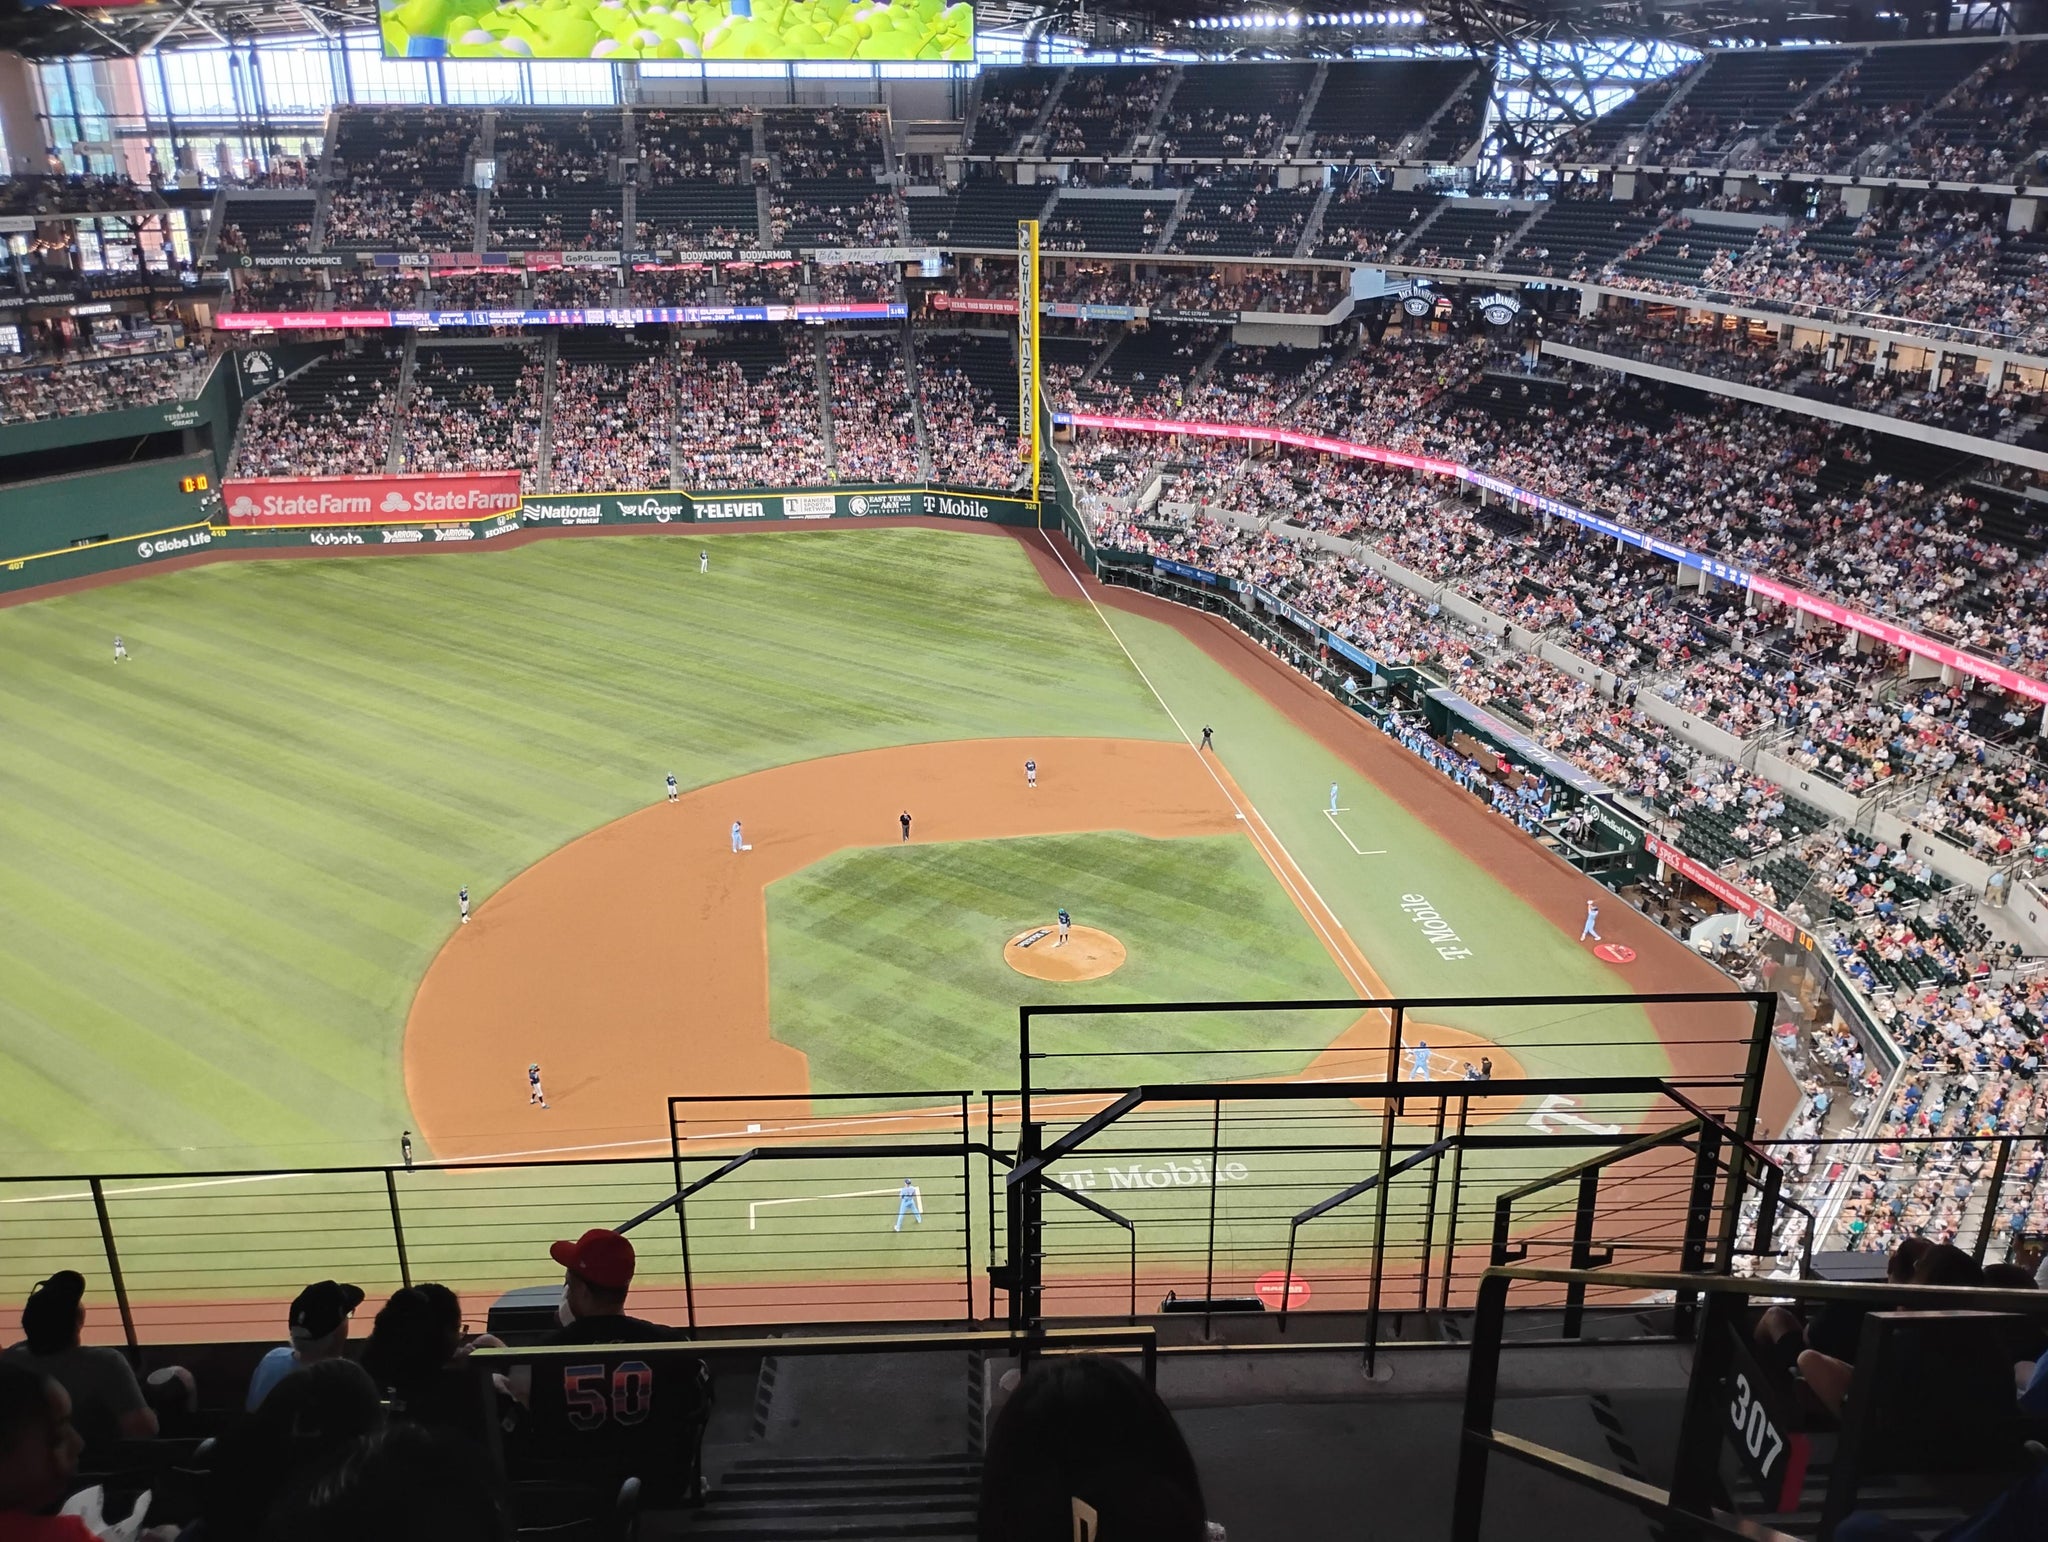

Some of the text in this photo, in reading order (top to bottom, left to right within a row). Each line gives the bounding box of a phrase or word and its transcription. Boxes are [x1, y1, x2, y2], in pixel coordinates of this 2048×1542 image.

[255, 256, 342, 265] PRIORITY COMMERCE
[398, 255, 430, 264] 105.3
[536, 254, 560, 263] PGL
[565, 254, 617, 262] GoPGL.com
[630, 254, 654, 262] PGL
[680, 251, 733, 261] BODYARMOR
[740, 250, 792, 261] BODYARMOR
[818, 248, 842, 260] Blue
[849, 248, 878, 260] Mint
[38, 293, 75, 304] ROOFING
[92, 286, 151, 300] PLUCKERS
[1021, 254, 1030, 336] CHIKIN
[1399, 285, 1436, 304] JACK DANIEL'S
[78, 304, 112, 315] AUTHENTICS
[1004, 304, 1014, 312] YOU
[1479, 296, 1496, 310] JACK
[1496, 292, 1521, 313] DANIEL'S
[1023, 378, 1031, 432] FARE
[164, 411, 199, 421] TEREMANA
[638, 498, 683, 523] Kroger
[694, 502, 764, 518] 7-ELEVEN
[939, 498, 989, 518] Mobile
[391, 530, 419, 540] ARROW
[444, 528, 470, 538] ARROW
[485, 522, 520, 538] HONDA
[155, 532, 212, 552] Globe Life
[310, 533, 364, 546] Kubota
[8, 562, 24, 570] 407
[1257, 590, 1272, 605] American
[1751, 579, 1784, 600] Budweiser
[1796, 596, 1832, 618] Budweiser
[1294, 614, 1310, 630] American
[1845, 614, 1884, 638] Budweiser
[1898, 634, 1940, 660] Budweiser
[1956, 656, 2000, 682] Budweiser
[1600, 812, 1637, 845] Medical City
[1658, 846, 1680, 868] SPEC'S
[1400, 893, 1461, 944] Mobile
[1766, 914, 1794, 942] SPEC'S
[1104, 1158, 1249, 1192] Mobile
[564, 1361, 652, 1431] 50
[1730, 1373, 1783, 1479] 307
